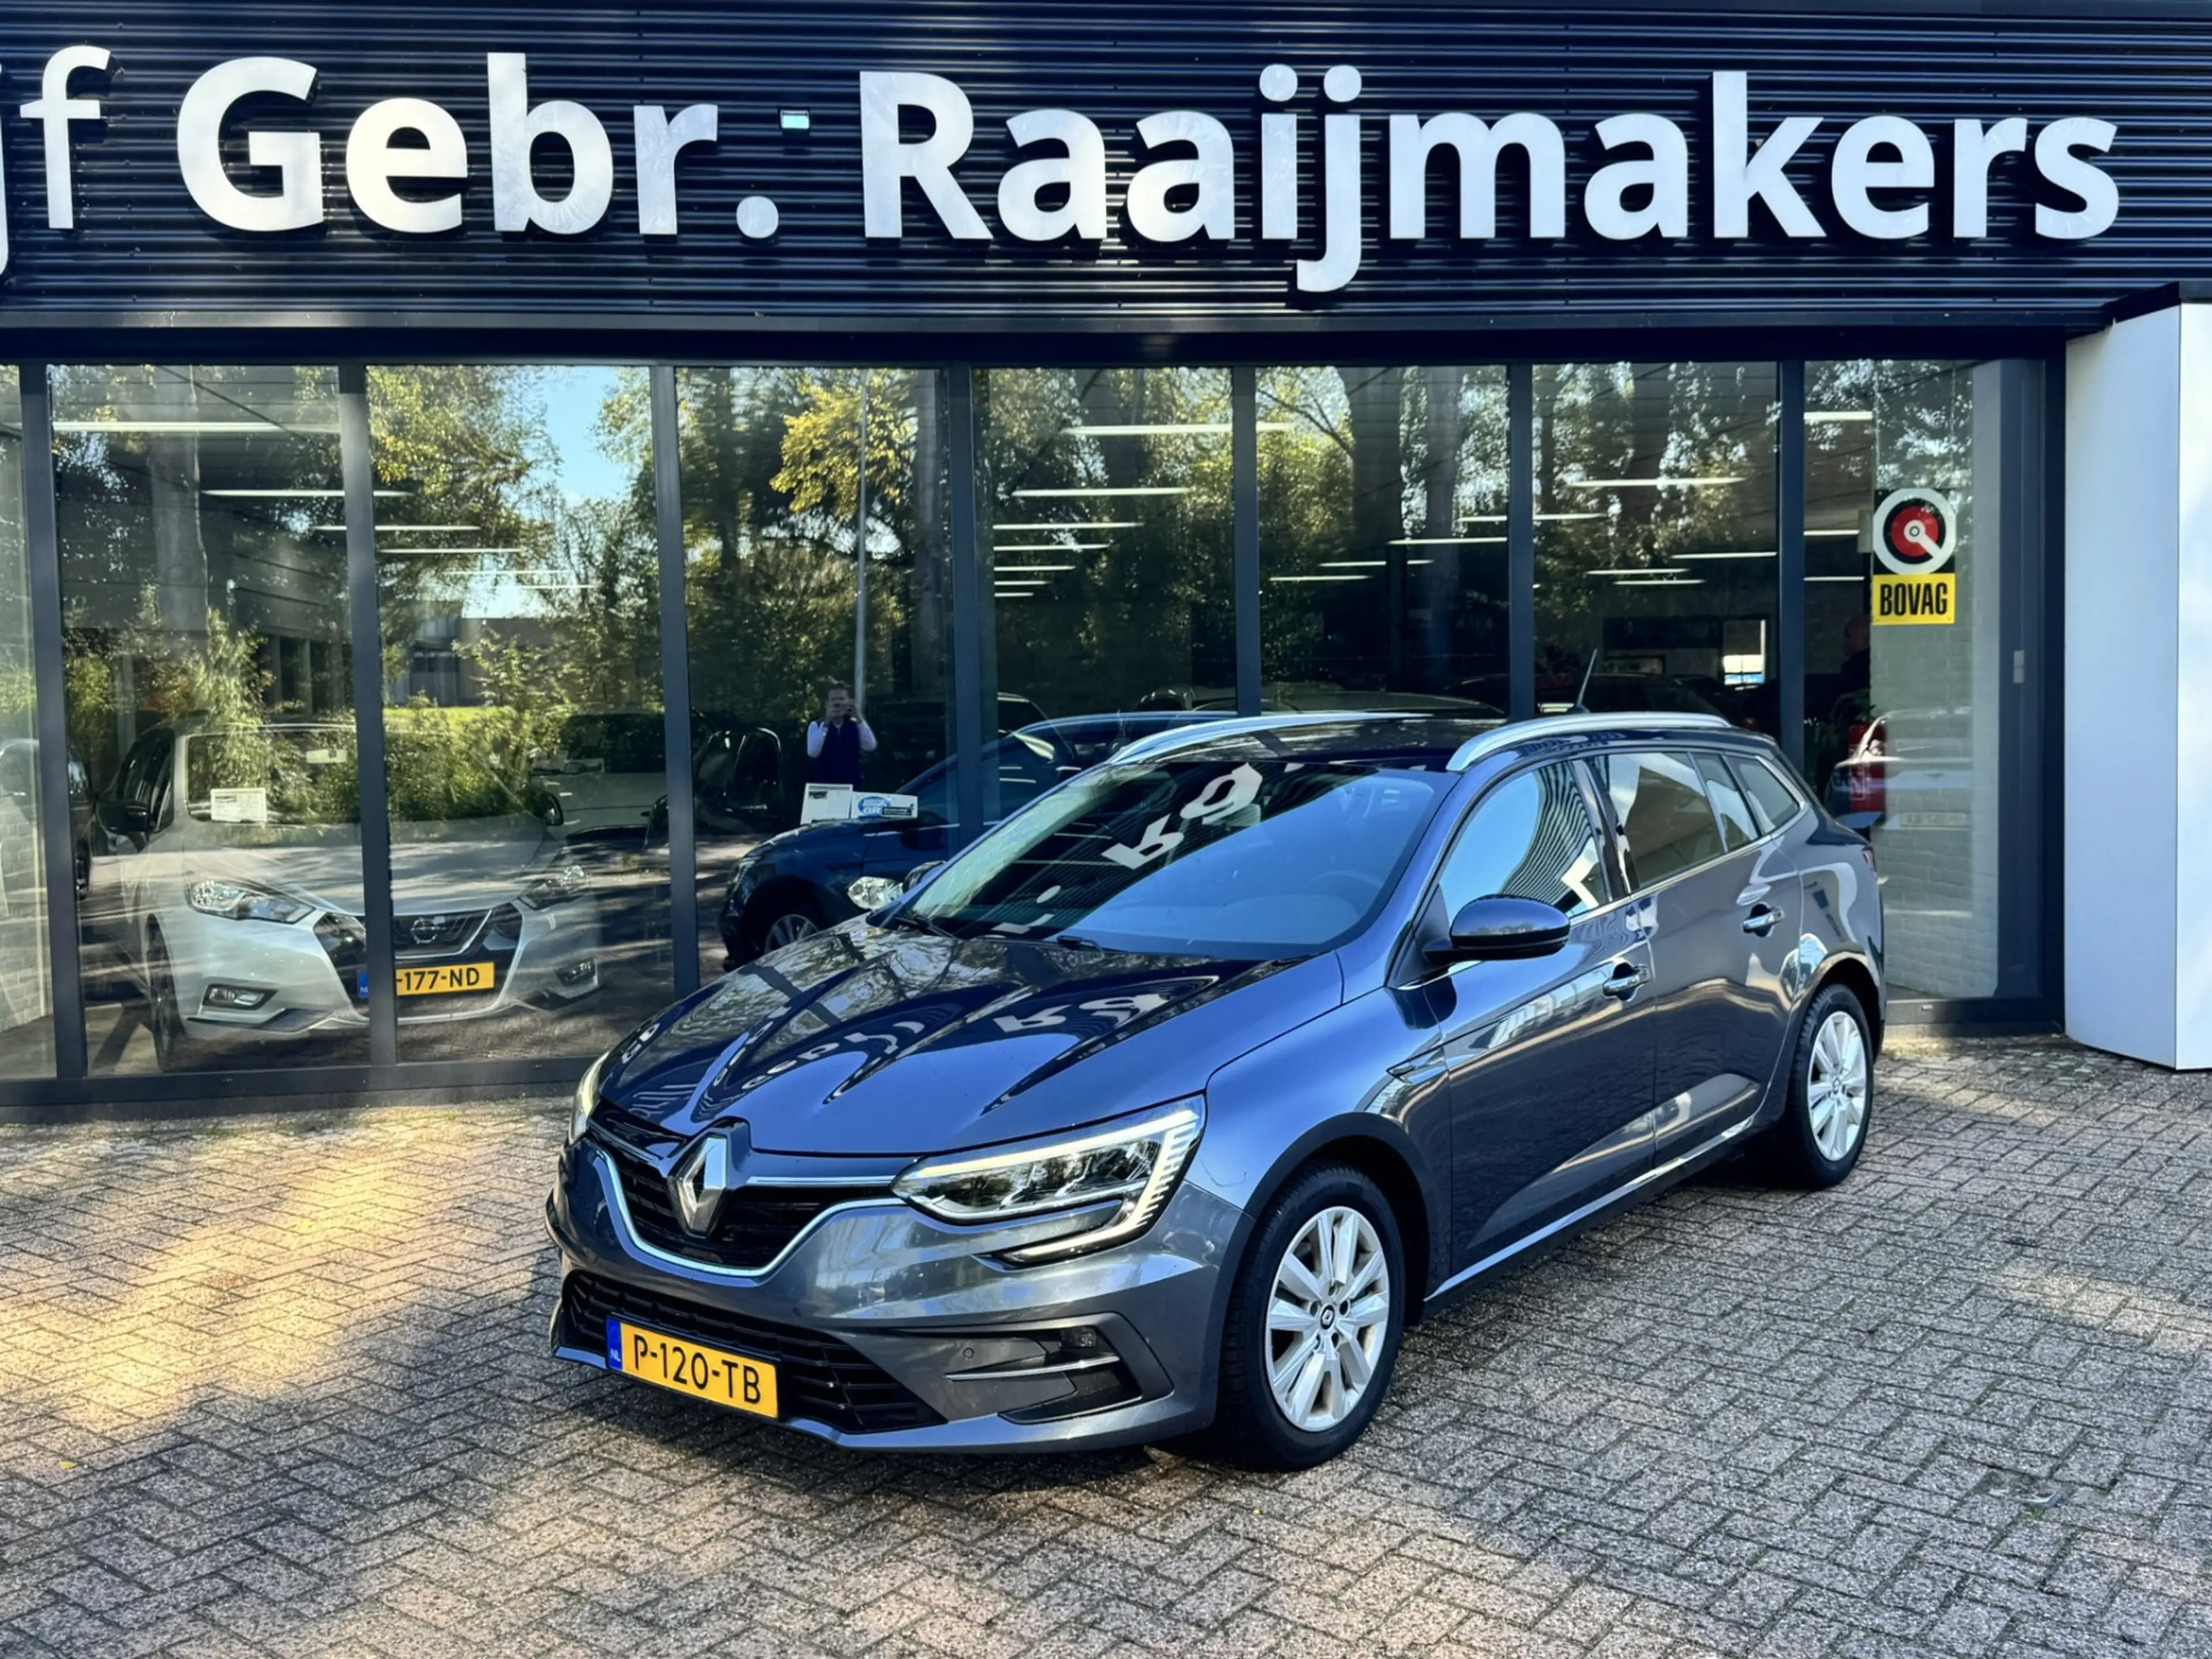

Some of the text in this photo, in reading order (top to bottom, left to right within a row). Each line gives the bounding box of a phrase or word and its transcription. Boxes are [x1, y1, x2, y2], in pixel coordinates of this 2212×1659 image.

[0, 45, 2120, 292] f Gebr. Raaijmakers
[1880, 582, 1948, 616] BOVAG
[397, 967, 480, 990] -177-ND
[633, 1334, 762, 1404] P-120-TB
